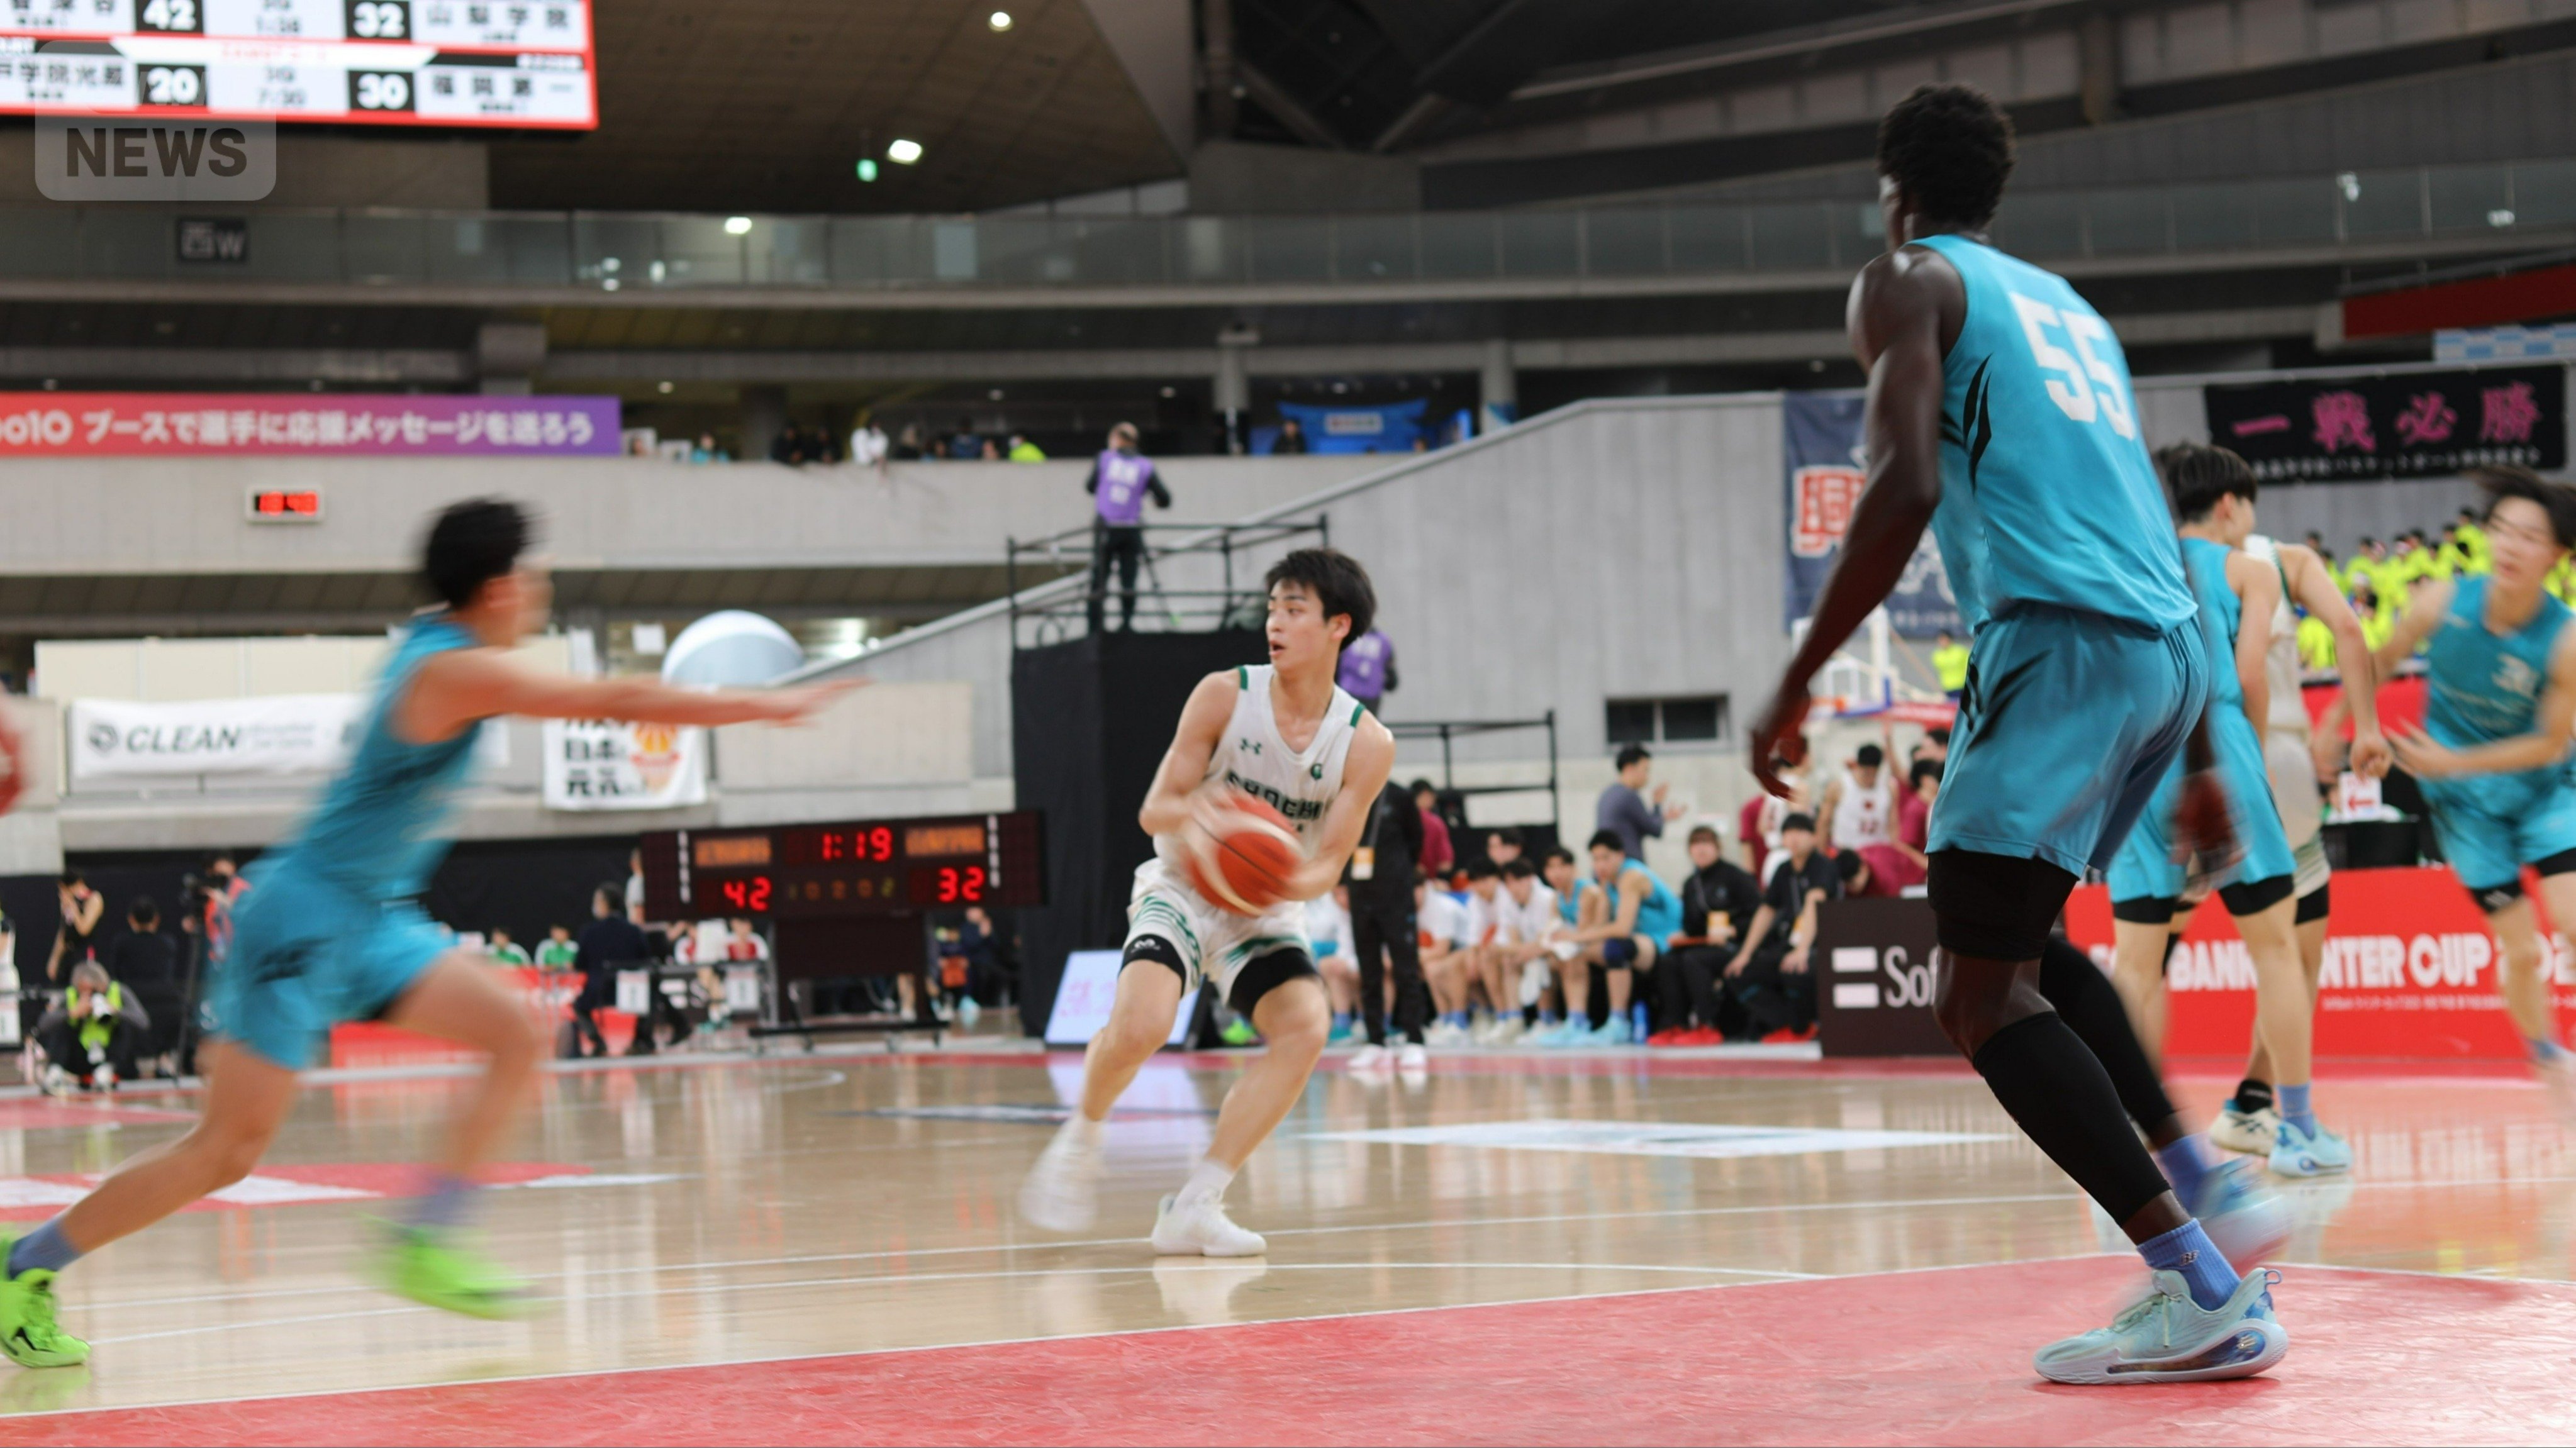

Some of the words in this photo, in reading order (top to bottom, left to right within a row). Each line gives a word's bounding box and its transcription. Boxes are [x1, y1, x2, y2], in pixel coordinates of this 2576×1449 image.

[143, 1, 198, 30] 42
[353, 2, 404, 37] 32
[147, 67, 199, 103] 20
[357, 74, 409, 109] 30
[2008, 291, 2136, 441] 55
[126, 724, 242, 753] CLEAN
[822, 826, 893, 862] 1:19
[723, 876, 772, 911] 42
[938, 865, 985, 903] 32
[2318, 936, 2406, 989] NTER
[2409, 933, 2492, 987] CUP
